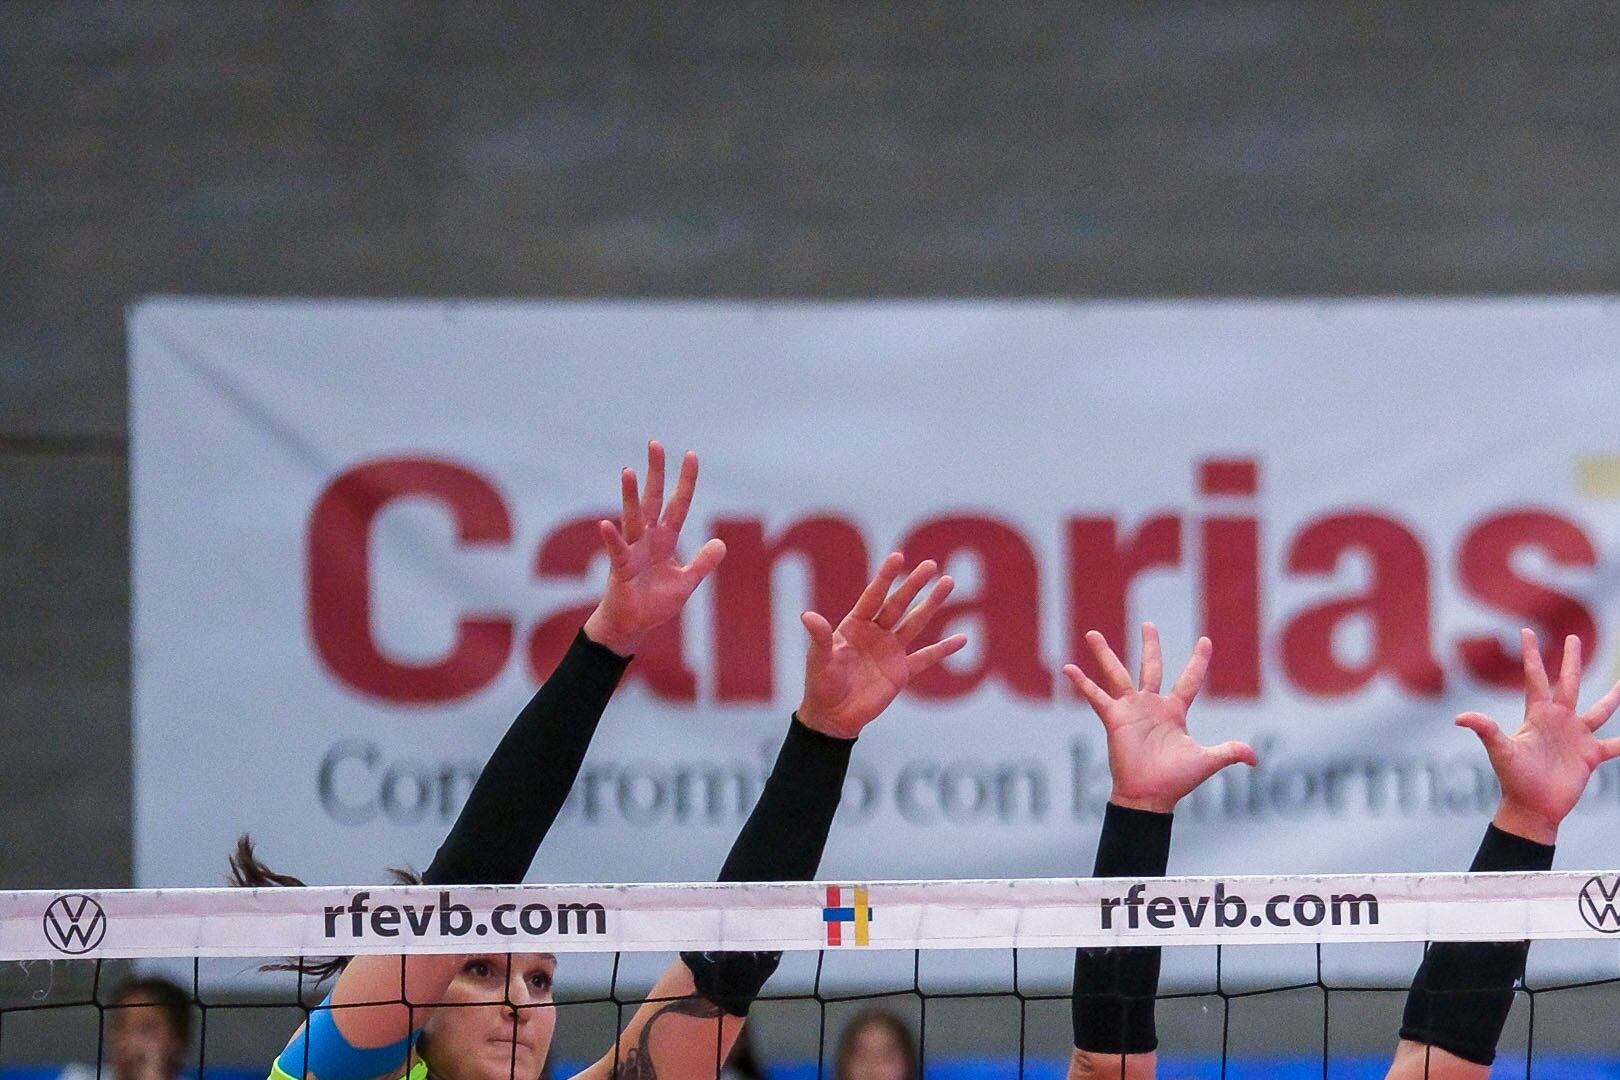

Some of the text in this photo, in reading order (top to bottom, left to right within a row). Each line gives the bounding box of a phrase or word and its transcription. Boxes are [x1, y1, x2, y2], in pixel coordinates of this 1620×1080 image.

[894, 756, 1050, 827] con
[323, 892, 607, 938] rfevb.com
[1099, 883, 1380, 929] rfevb.com
